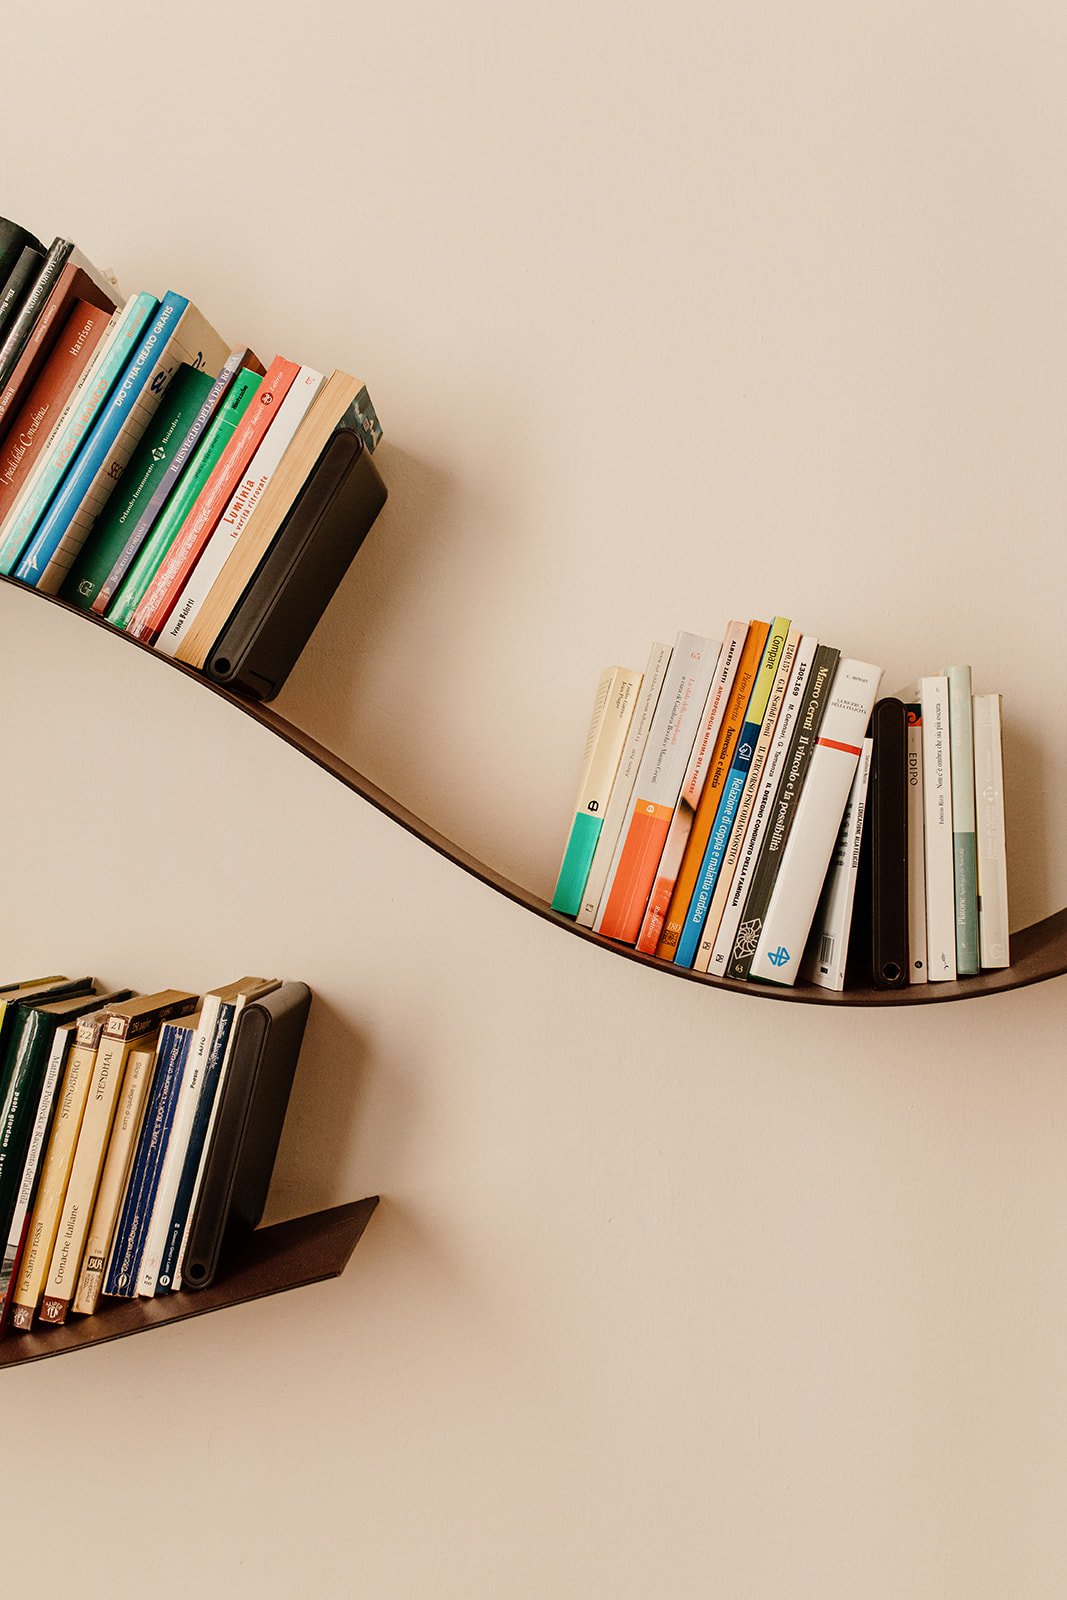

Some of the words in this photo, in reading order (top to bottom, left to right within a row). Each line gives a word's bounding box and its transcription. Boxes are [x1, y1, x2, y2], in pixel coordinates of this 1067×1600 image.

[38, 258, 57, 285] MAURO
[23, 284, 44, 315] CORONA
[152, 304, 174, 335] GRATIS
[68, 317, 95, 356] Harrison
[134, 333, 158, 366] CREATO
[127, 364, 141, 380] HA
[220, 354, 239, 381] ROSSA
[113, 388, 128, 407] DIO
[122, 378, 133, 390] CI
[210, 378, 226, 398] DEA
[229, 383, 249, 410] Nietzsche
[53, 436, 78, 469] FIORI
[71, 423, 85, 437] DI
[78, 377, 110, 423] BANCO
[197, 396, 216, 423] DELLA
[160, 417, 180, 444] Boiardo
[174, 421, 202, 464] RISVEGLIO
[7, 442, 27, 463] della
[0, 458, 22, 483] piedi
[169, 461, 180, 472] IL
[117, 496, 137, 524] Orlando
[131, 461, 156, 499] Innamorato
[222, 476, 256, 525] Luminia
[233, 507, 251, 531] verità
[245, 473, 269, 508] ritrovate
[169, 617, 185, 637] Ivana
[724, 639, 736, 666] ALBERTO
[763, 633, 784, 671] Compare
[780, 642, 795, 672] 1240.157
[719, 666, 729, 683] ZATTI
[738, 671, 752, 693] Pietro
[791, 661, 807, 697] 1305.169
[811, 665, 828, 699] Mauro
[705, 684, 723, 731] ANTROPOLOGIA
[730, 692, 745, 722] Barbetta
[767, 694, 781, 718] Scafidi
[786, 703, 794, 712] M.
[802, 698, 819, 731] Ceruti
[762, 718, 774, 737] Fonti
[778, 712, 792, 740] Gennari,
[934, 721, 943, 730] più
[698, 731, 710, 756] MINIMA
[719, 725, 736, 761] Anoressia
[757, 745, 766, 754] IL
[776, 740, 783, 749] G.
[798, 735, 809, 744] Il
[934, 739, 942, 749] che
[746, 753, 764, 793] PERCORSO
[767, 749, 781, 778] Tamanza
[787, 744, 806, 782] vincolo
[909, 751, 918, 785] EDIPO
[710, 766, 723, 789] isteria
[785, 781, 793, 789] e
[723, 776, 743, 816] Relazione
[756, 789, 769, 818] DISEGNO
[782, 790, 794, 801] la
[720, 814, 731, 824] di
[726, 792, 753, 866] PSICODIAGNOSTICO
[766, 800, 790, 852] possibilità
[854, 801, 865, 835] L'EDUCAZIONE
[711, 823, 728, 851] coppia
[746, 818, 761, 856] CONGIUNTO
[853, 835, 861, 847] ALLA
[701, 856, 720, 891] malattia
[740, 855, 751, 876] DELLA
[731, 876, 745, 907] FAMIGLIA
[691, 890, 710, 924] cardiaca
[957, 896, 966, 924] Platone
[78, 1030, 91, 1040] 22
[110, 1022, 121, 1030] 21
[196, 1036, 206, 1056] SAFFO
[45, 1054, 60, 1090] Matthias
[94, 1050, 114, 1101] STENDHAL
[132, 1060, 142, 1079] Silone
[189, 1069, 198, 1089] Poesie
[8, 1090, 20, 1112] paolo
[60, 1059, 82, 1119] STRINDBERG
[124, 1087, 135, 1109] segreto
[36, 1089, 52, 1124] Politycki
[0, 1112, 16, 1148] giordano
[121, 1116, 129, 1131] Luca
[27, 1130, 42, 1167] Racconto
[31, 1221, 44, 1247] rossa
[53, 1239, 71, 1285] Cronache
[63, 1203, 79, 1239] italiane
[24, 1248, 37, 1278] stanza
[20, 1279, 30, 1292] La
